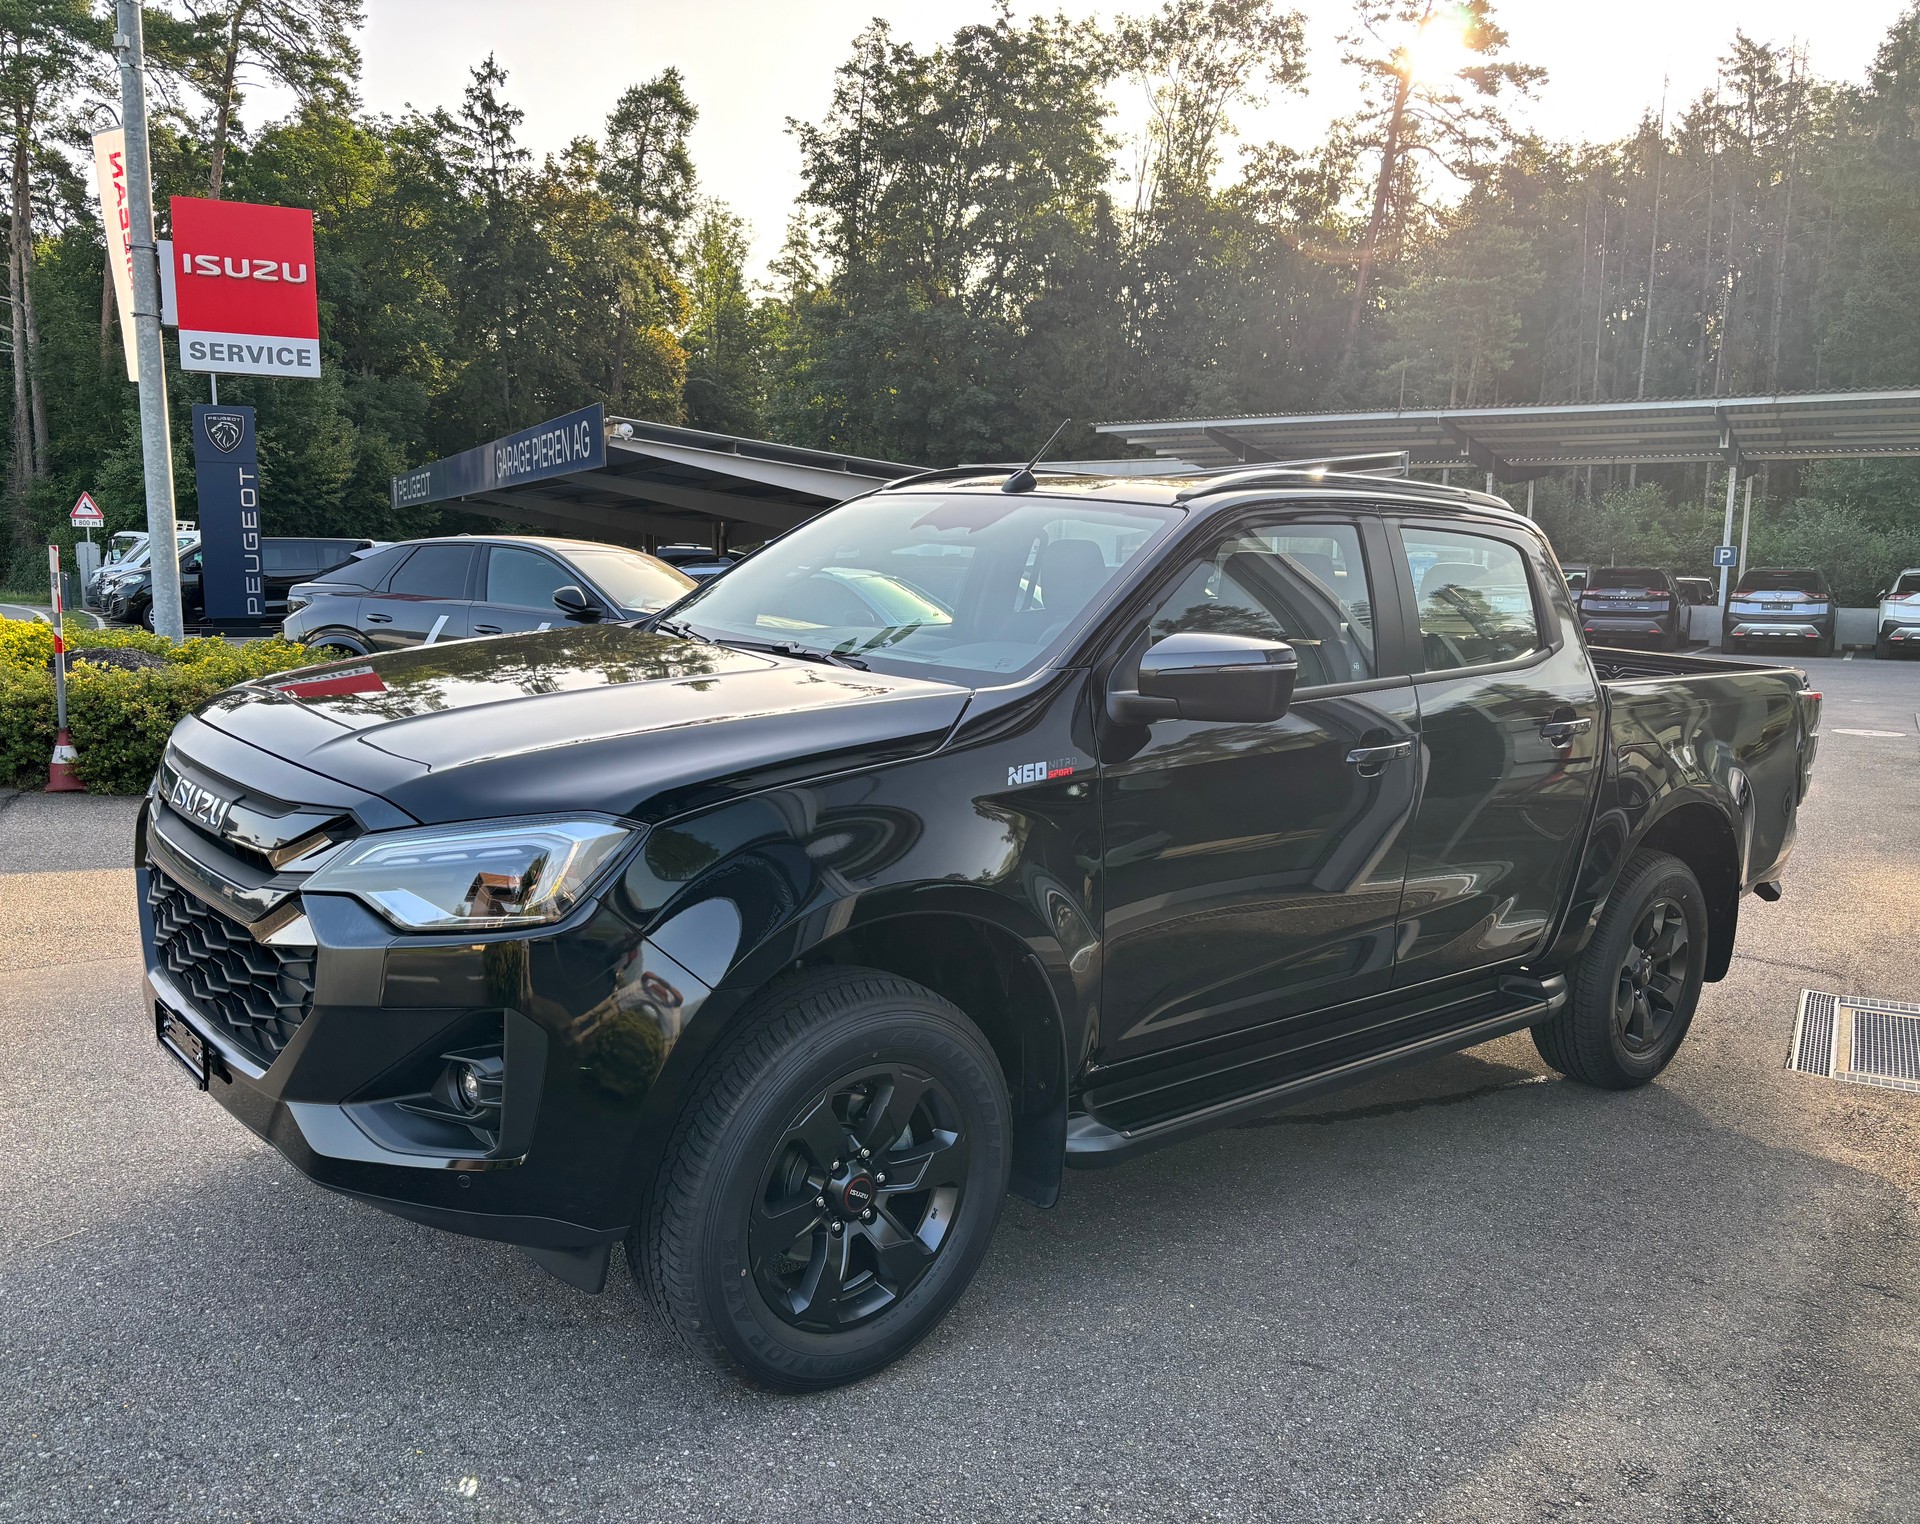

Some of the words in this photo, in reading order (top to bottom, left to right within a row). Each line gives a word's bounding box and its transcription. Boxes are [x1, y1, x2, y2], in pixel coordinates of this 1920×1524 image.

[182, 253, 307, 283] ISUZU
[189, 341, 312, 367] SERVICE
[496, 440, 531, 479] GARAGE
[532, 426, 571, 470] PIEREN
[573, 420, 591, 461] AG
[398, 471, 431, 502] PEUGEOT
[238, 467, 263, 615] PEUGEOT
[1719, 549, 1732, 564] P
[1007, 761, 1047, 786] N60
[1048, 757, 1078, 769] NITRO
[1048, 767, 1076, 780] SPORT
[170, 775, 230, 830] ISUZU
[849, 1189, 869, 1200] ISUZU
